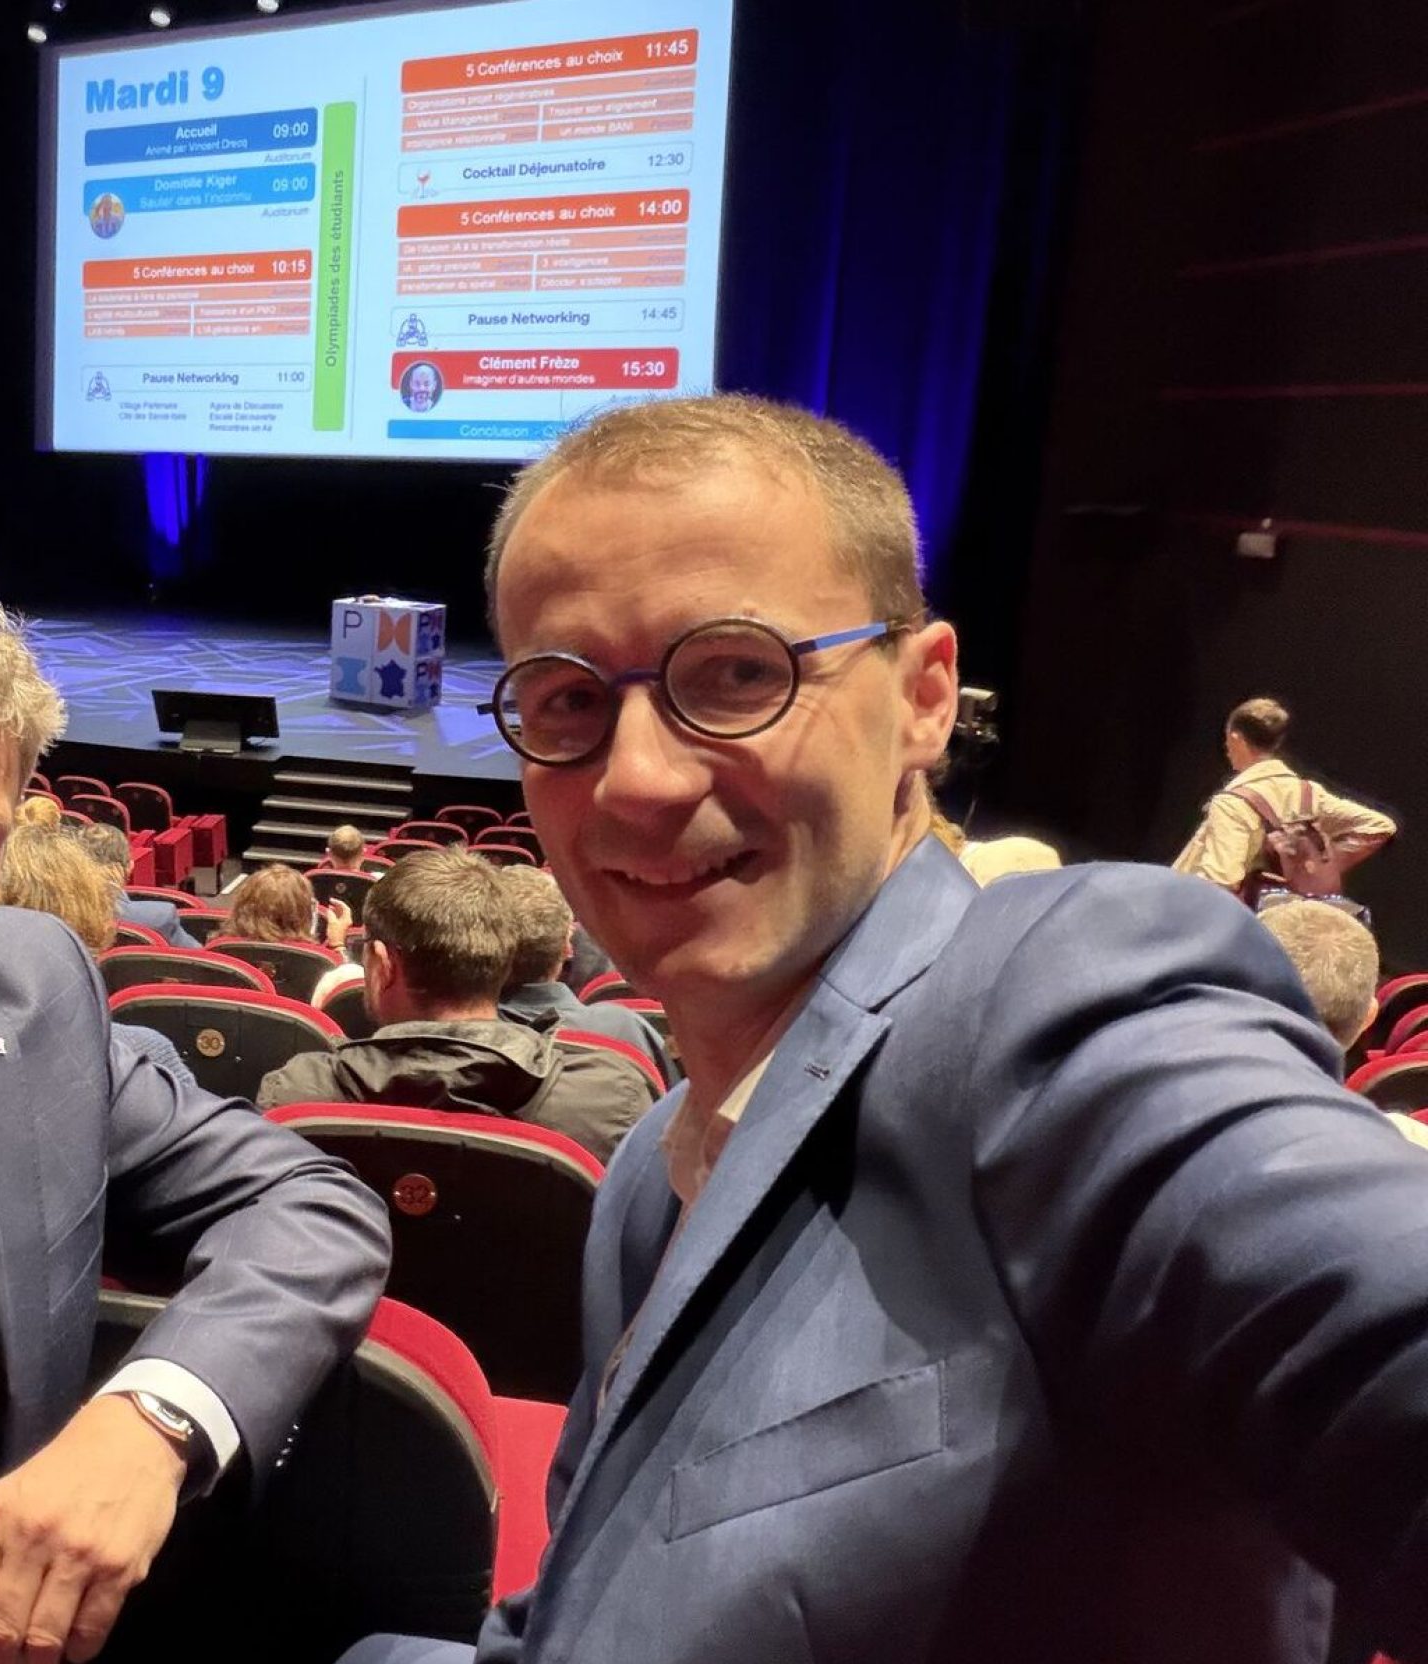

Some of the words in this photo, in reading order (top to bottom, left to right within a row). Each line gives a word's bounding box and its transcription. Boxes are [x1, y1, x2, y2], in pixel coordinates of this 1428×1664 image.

[644, 38, 689, 58] 11:45
[465, 63, 475, 78] 5
[477, 54, 562, 77] Conférences
[565, 53, 584, 67] au
[586, 48, 623, 65] choix
[86, 70, 189, 114] Mardi
[201, 66, 225, 101] 9
[175, 123, 218, 140] Accueil
[273, 121, 309, 139] 09:00
[172, 144, 188, 157] par
[188, 139, 221, 153] Vincent
[462, 162, 516, 180] Cocktail
[518, 157, 606, 177] Déjeunatoire
[647, 151, 685, 168] 12:30
[272, 176, 309, 193] 09:00
[175, 194, 202, 207] dans
[331, 169, 345, 241] étudiants
[637, 199, 683, 217] 14:00
[460, 211, 470, 226] 5
[472, 206, 556, 226] Conférences
[558, 205, 578, 220] au
[579, 201, 616, 218] choix
[271, 258, 307, 275] 10:15
[330, 247, 341, 274] des
[132, 266, 141, 280] 5
[141, 263, 208, 279] Conférences
[210, 264, 225, 277] au
[226, 261, 255, 276] choix
[467, 312, 509, 327] Pause
[510, 310, 591, 328] Networking
[640, 306, 678, 322] 14:45
[324, 279, 340, 368] Olympiades
[479, 356, 537, 371] Clément
[621, 360, 665, 377] 15:30
[142, 372, 174, 384] Pause
[176, 372, 240, 386] Networking
[277, 371, 305, 383] 11:00
[462, 372, 508, 387] Imaginer
[508, 371, 551, 386] d'autres
[552, 372, 596, 385] mondes
[459, 424, 529, 438] Conclusion
[343, 610, 364, 639] P
[200, 1034, 221, 1050] 30
